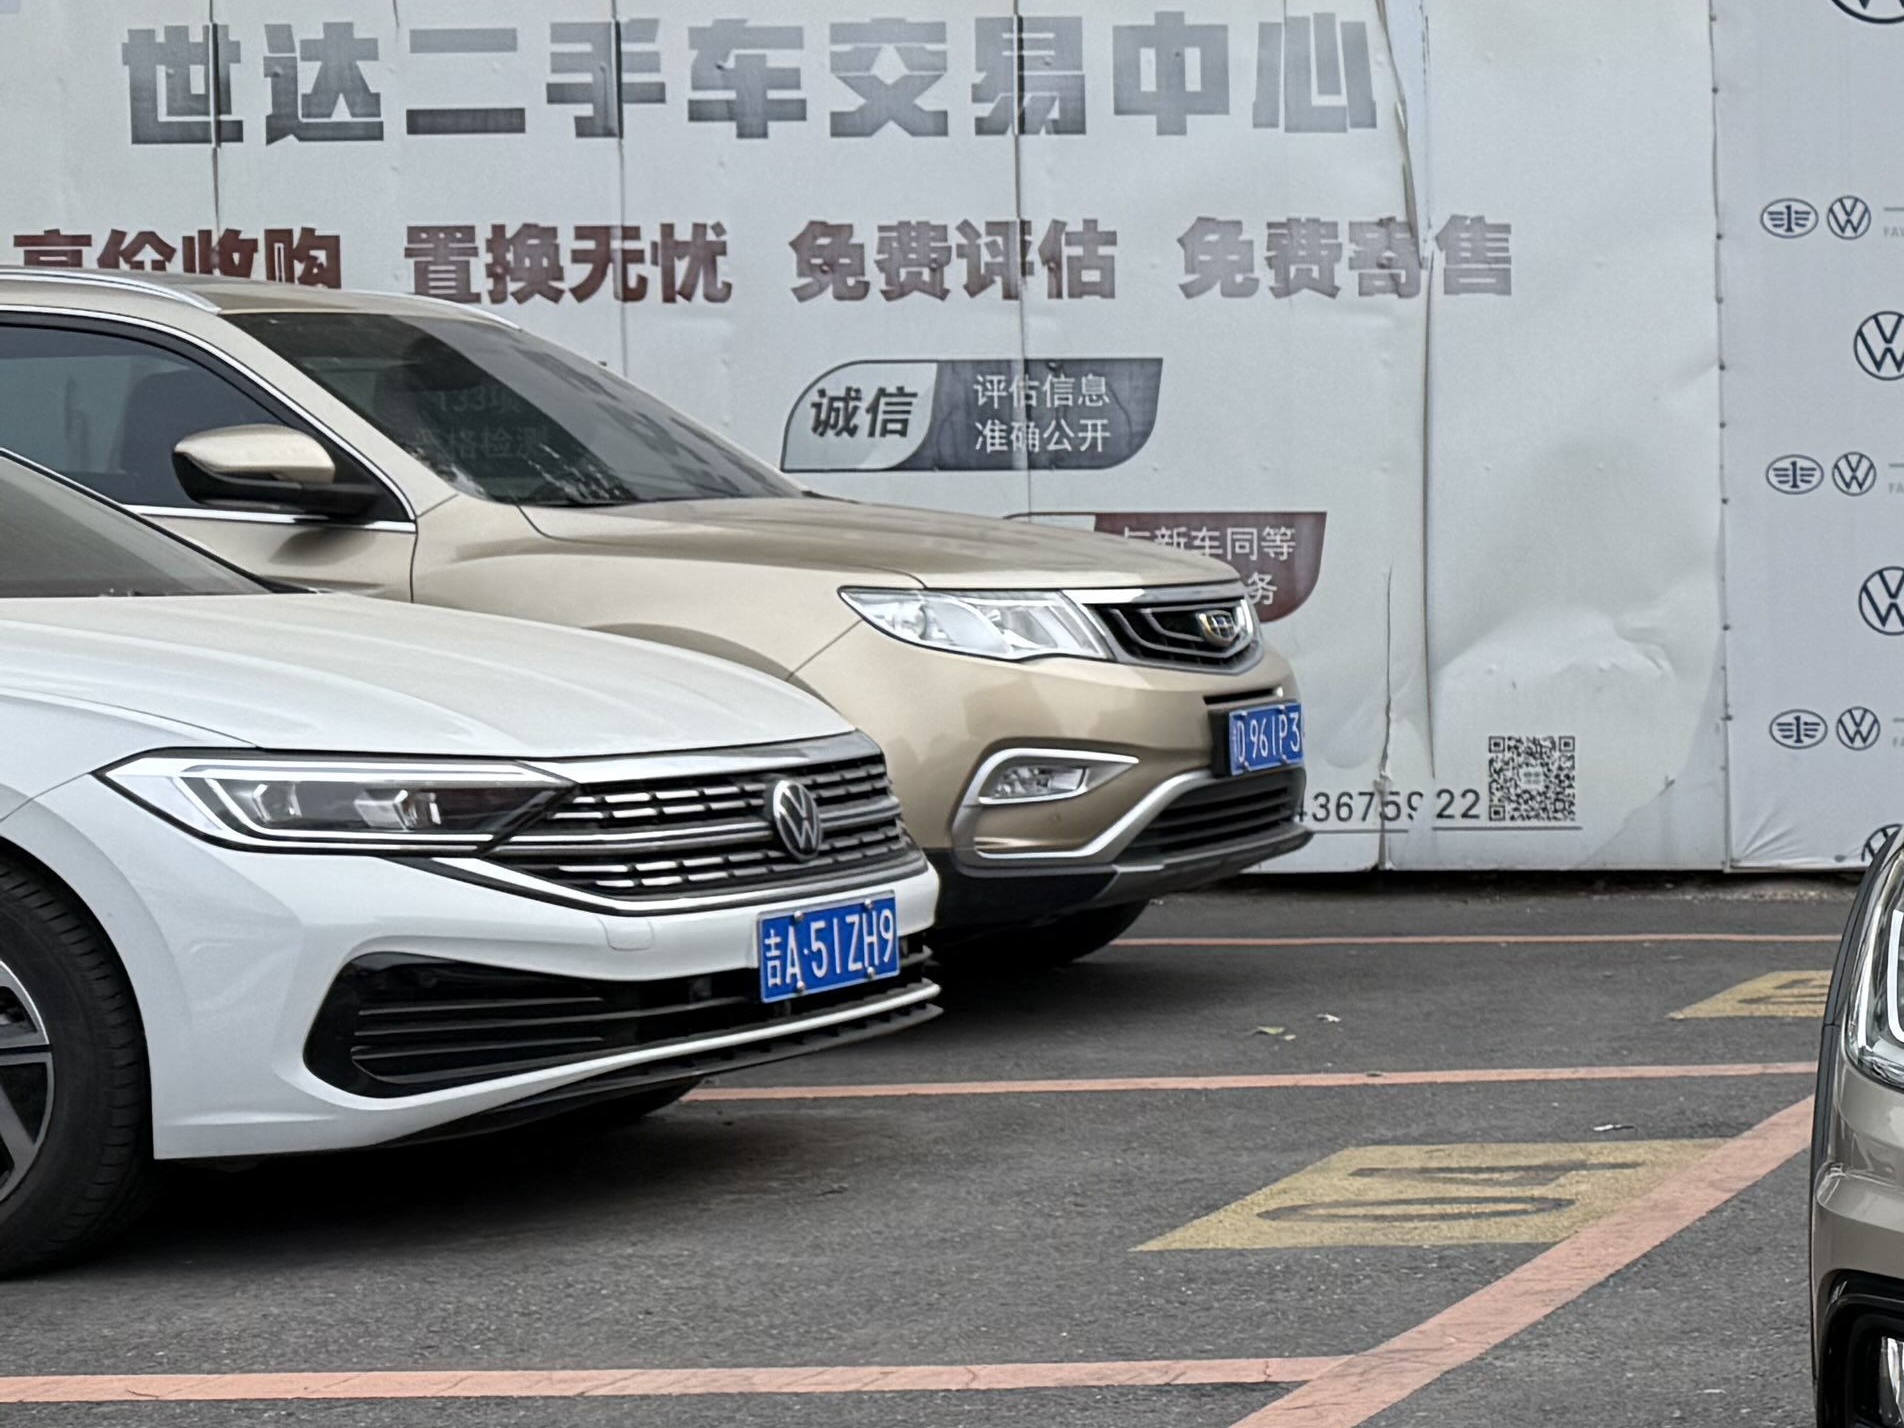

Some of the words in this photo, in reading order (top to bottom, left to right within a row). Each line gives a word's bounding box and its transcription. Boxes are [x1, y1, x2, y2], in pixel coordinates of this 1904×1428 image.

[121, 10, 1377, 146] 世达二手车交易中心
[404, 222, 733, 304] 置换无忧
[790, 218, 1118, 302] 免费评估
[1176, 214, 1513, 300] 免费寄售
[810, 385, 918, 440] 诚信
[973, 373, 1111, 408] 评估信息
[974, 418, 1112, 454] 准确公开
[1231, 711, 1301, 763] D961P3
